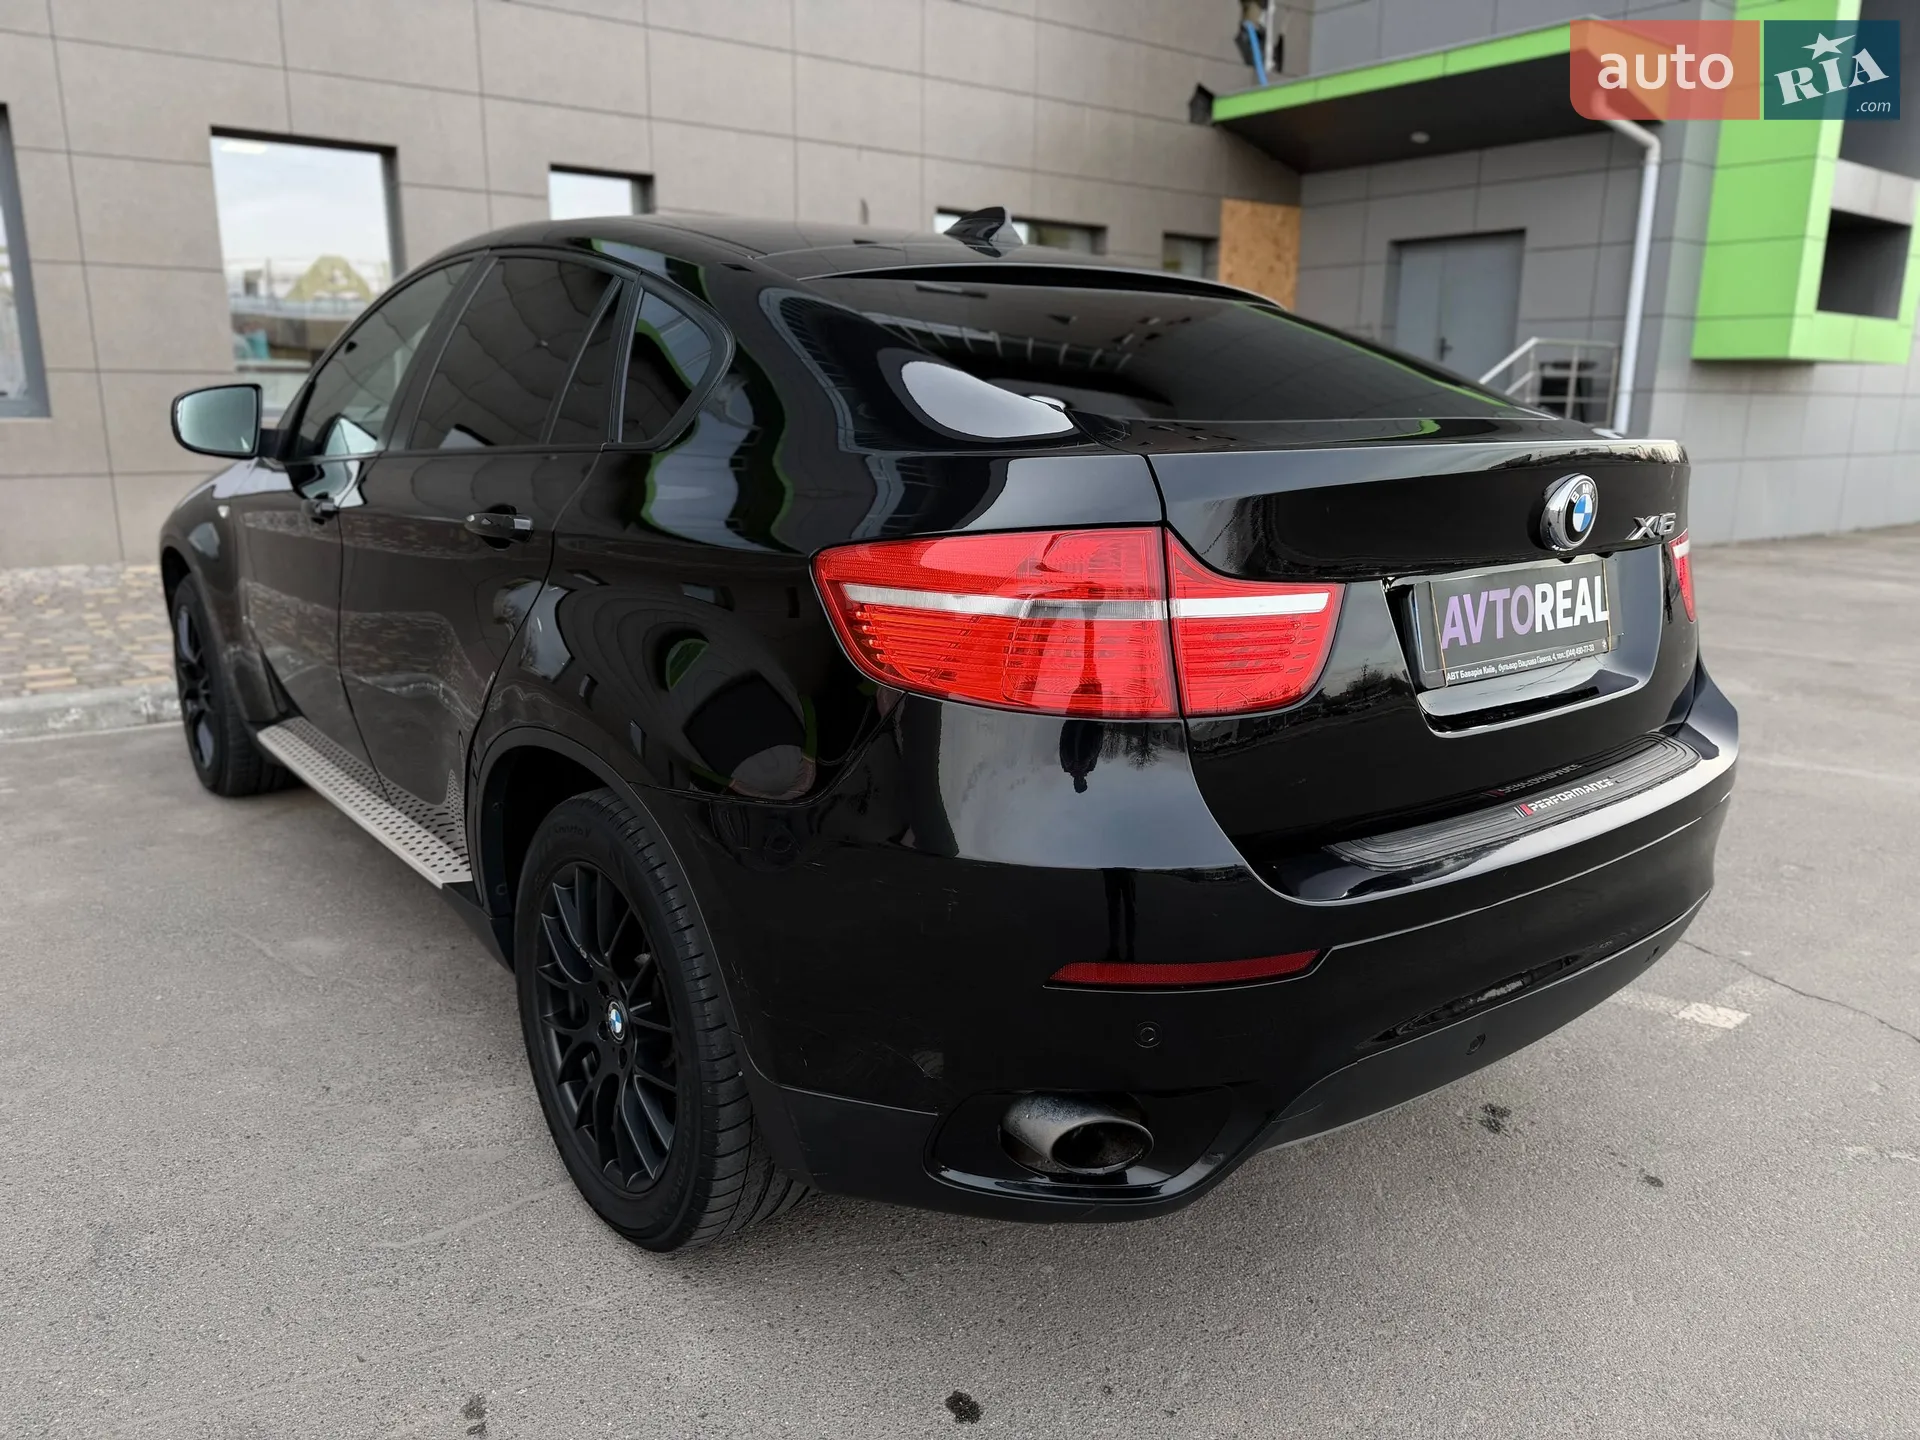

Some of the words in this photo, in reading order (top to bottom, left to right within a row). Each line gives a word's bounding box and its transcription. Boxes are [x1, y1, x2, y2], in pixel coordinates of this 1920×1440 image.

[1625, 512, 1676, 541] X6
[1441, 575, 1610, 650] AVTOREAL
[1528, 778, 1614, 812] PERFORMANCE
